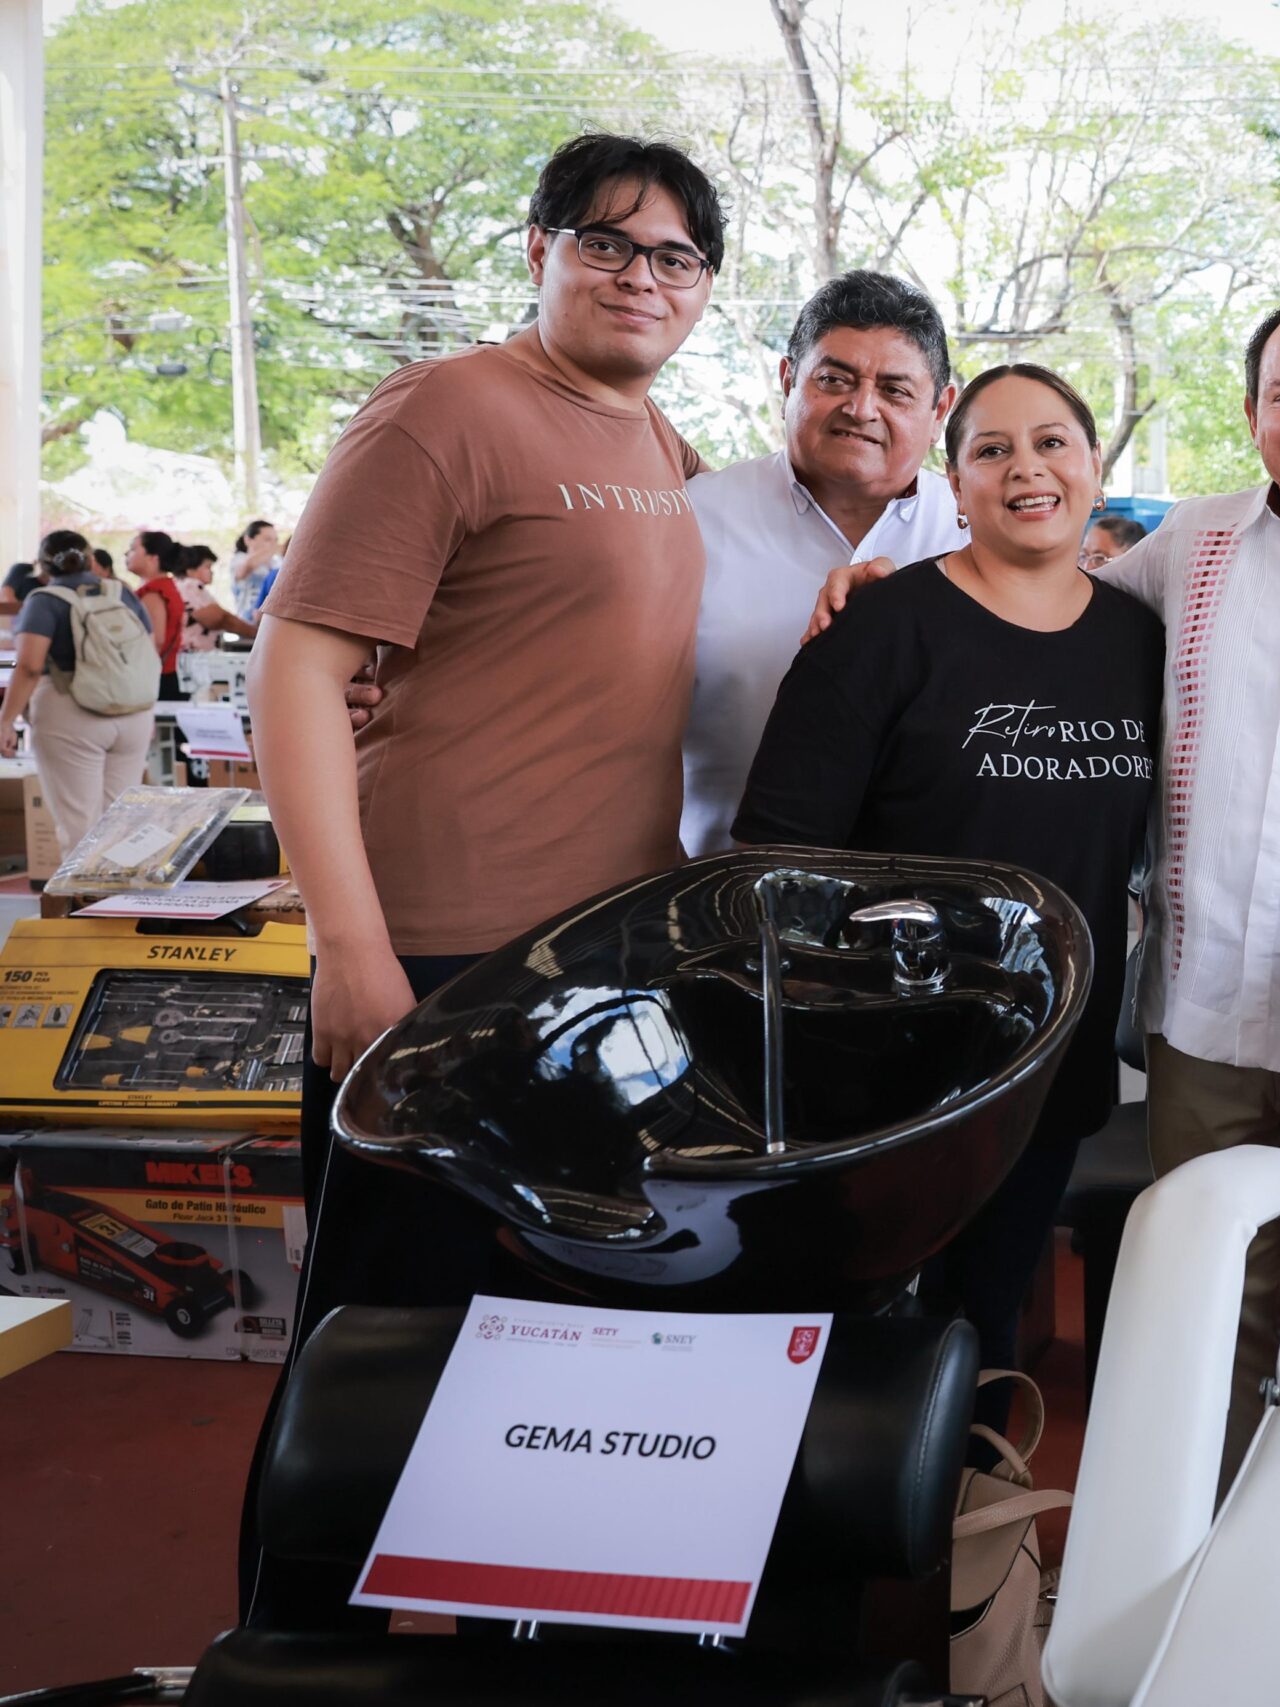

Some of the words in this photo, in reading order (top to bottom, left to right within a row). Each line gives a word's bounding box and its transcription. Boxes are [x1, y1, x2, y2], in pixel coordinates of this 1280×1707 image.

[146, 945, 238, 962] STANLEY
[4, 970, 33, 983] 150
[145, 1198, 169, 1210] Gato
[171, 1199, 184, 1210] de
[215, 1201, 267, 1215] Hiráulico
[510, 1325, 582, 1341] YUCATÁN
[592, 1327, 620, 1337] SETY
[665, 1334, 697, 1345] SNEY
[504, 1423, 593, 1454] GEMA
[600, 1430, 717, 1460] STUDIO
